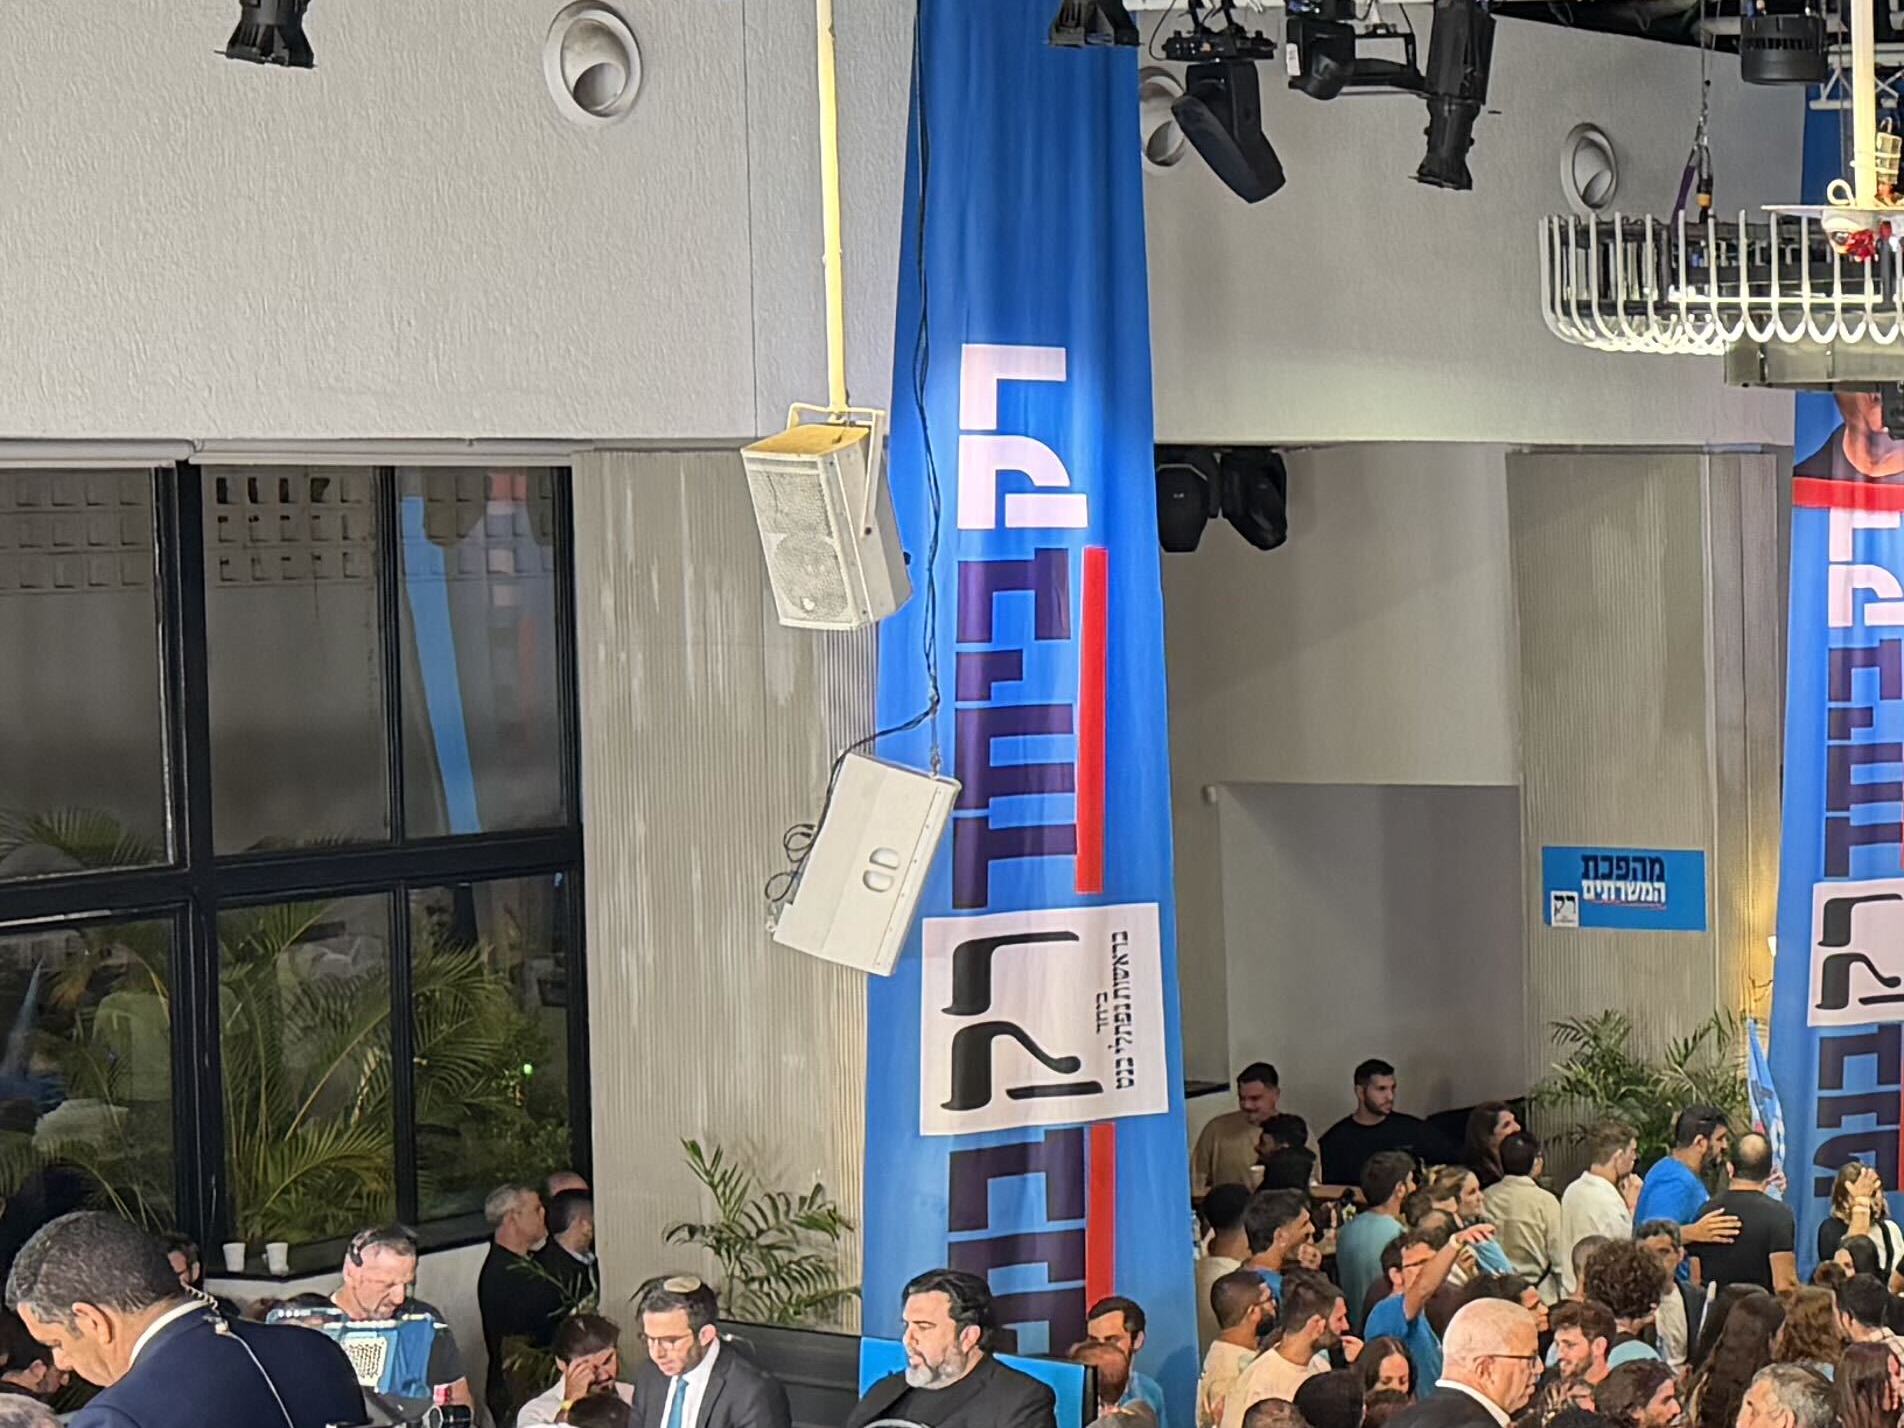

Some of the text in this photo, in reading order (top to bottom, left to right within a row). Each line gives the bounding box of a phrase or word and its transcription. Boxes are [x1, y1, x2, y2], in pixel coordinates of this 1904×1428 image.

[951, 343, 1089, 910] רק ביחד
[1824, 639, 1904, 878] ביחד
[1553, 895, 1576, 917] רק
[1581, 855, 1666, 882] מהפכת
[1581, 879, 1667, 904] המשרתים
[940, 930, 1104, 1111] רק
[1095, 992, 1109, 1035] ביחד
[1107, 931, 1135, 1090] בראשות נפתלי בנט
